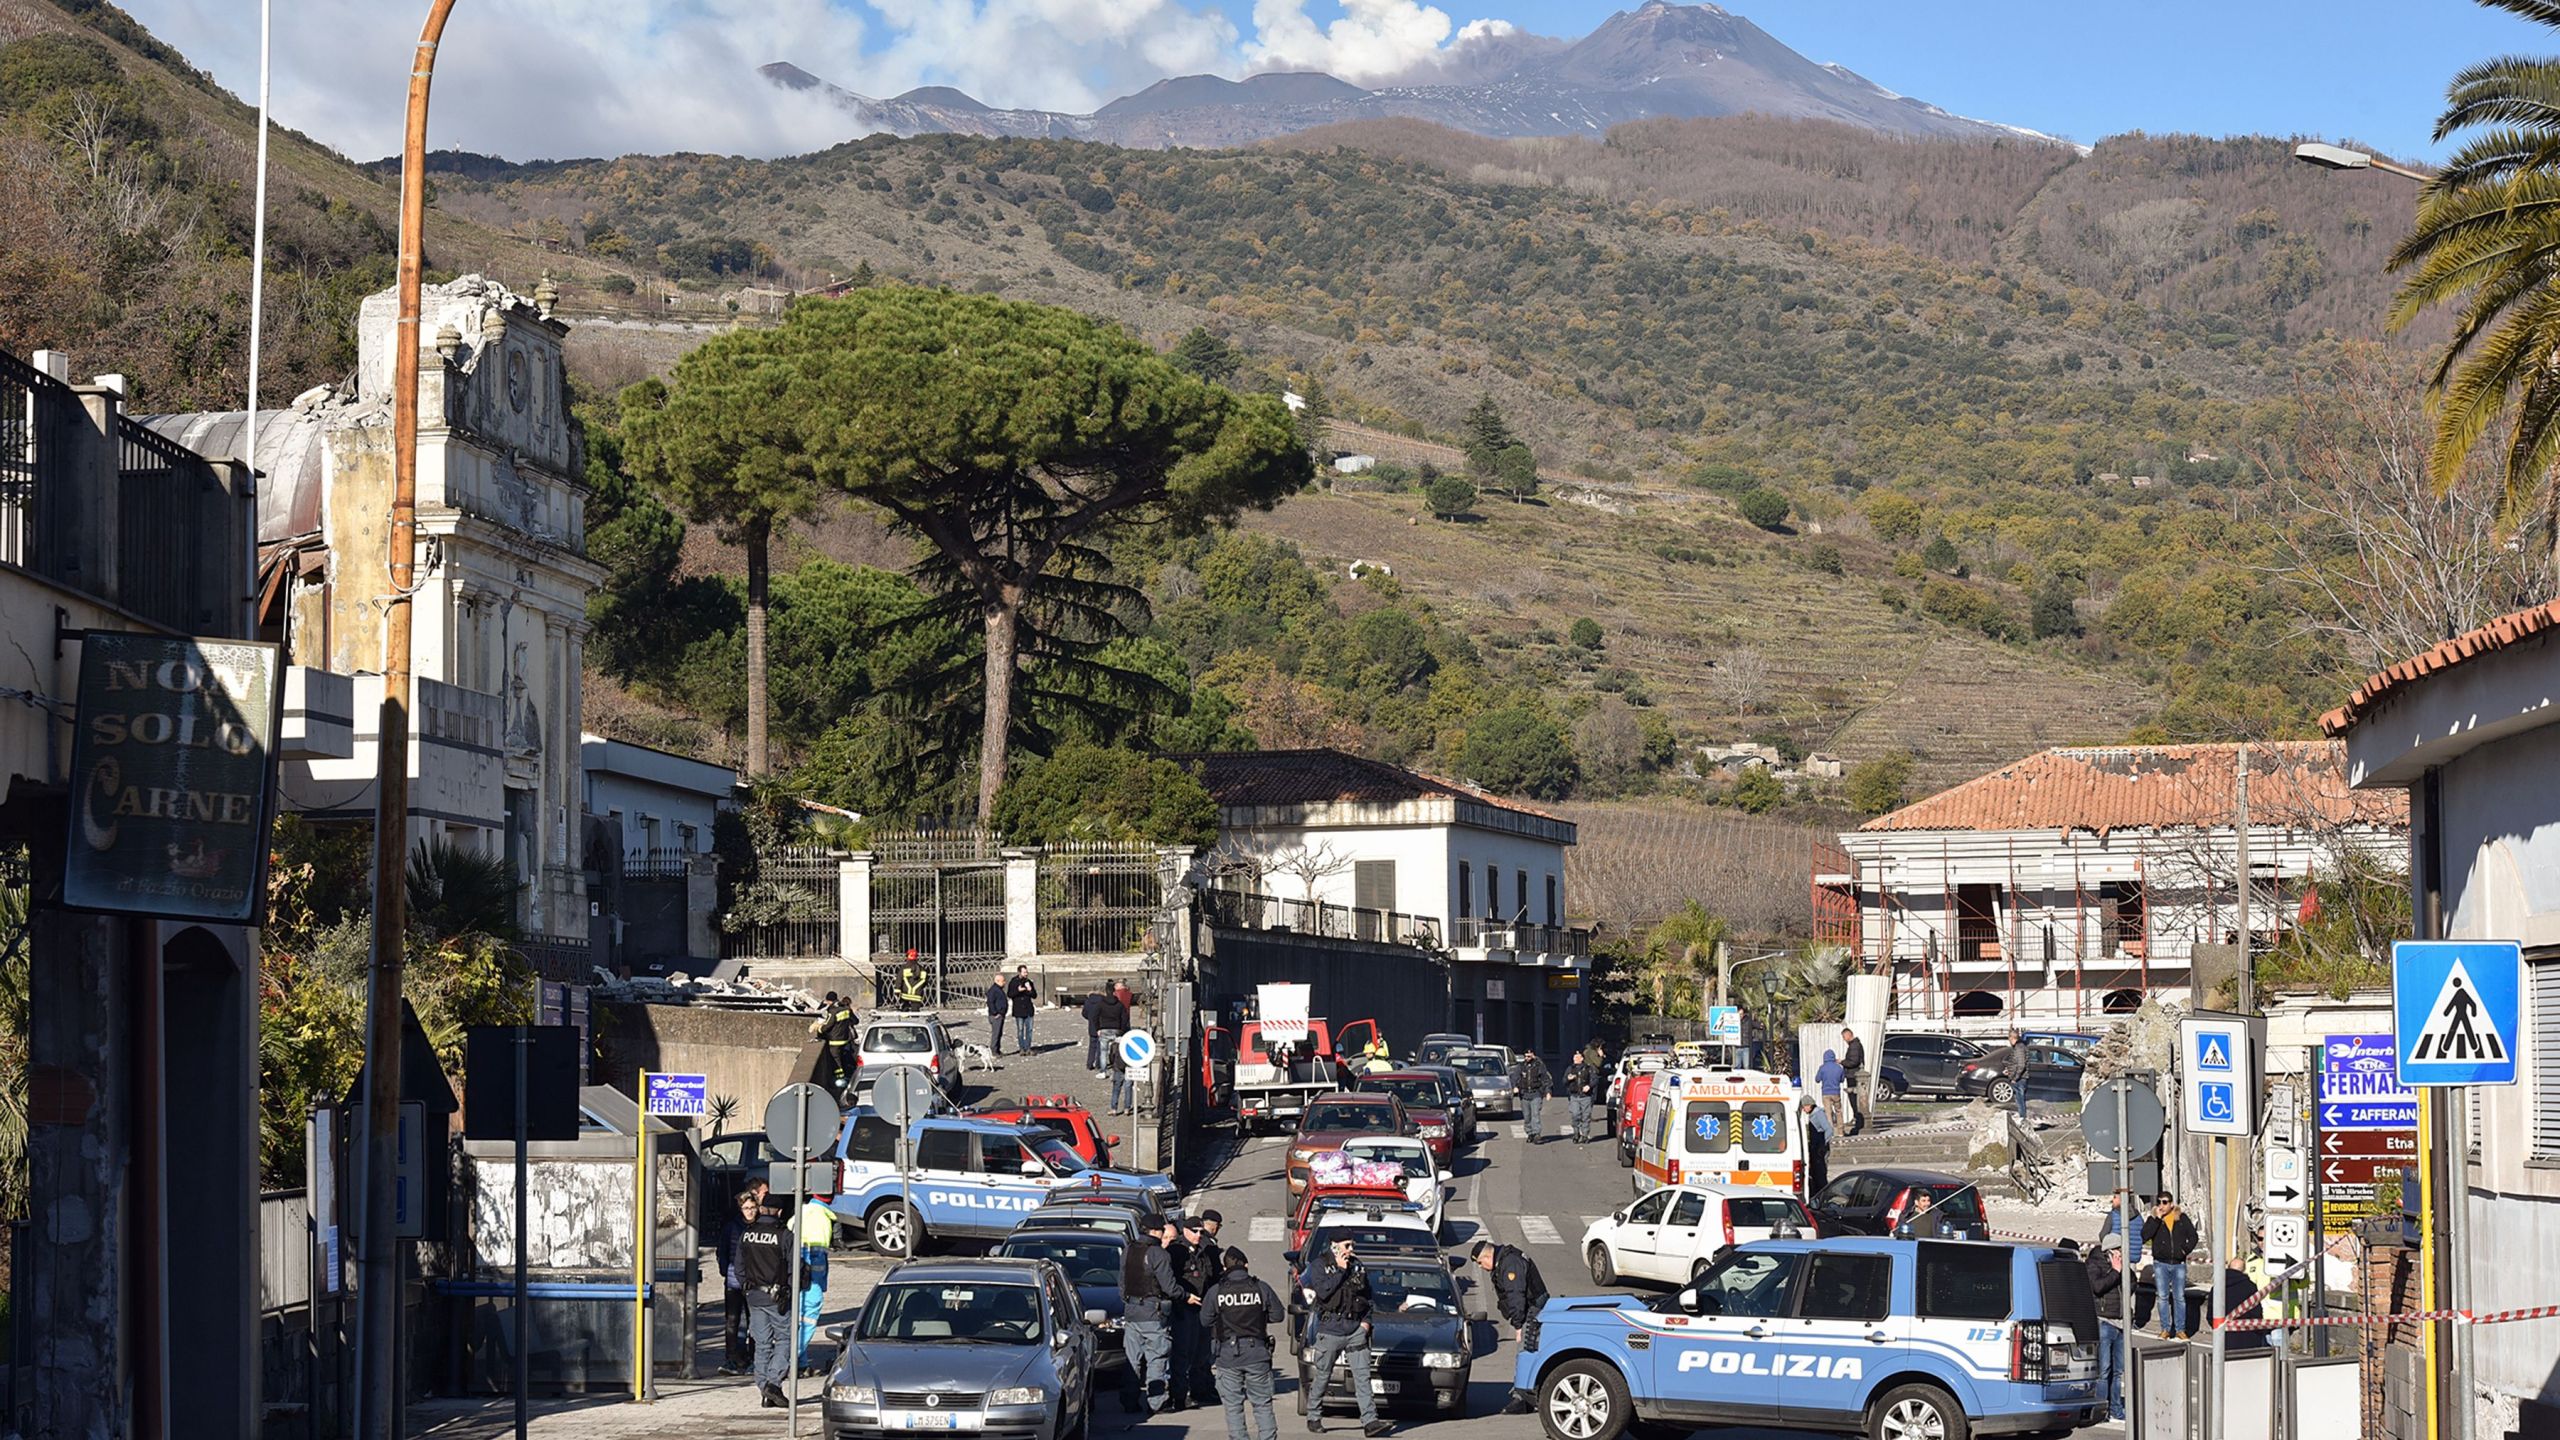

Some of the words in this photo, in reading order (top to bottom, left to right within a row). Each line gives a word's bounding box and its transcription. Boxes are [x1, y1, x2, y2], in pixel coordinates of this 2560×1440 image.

[104, 660, 258, 701] NON
[91, 711, 255, 756] SOLO
[83, 756, 252, 851] CARNE
[1688, 1085, 1781, 1096] AMBULANZA
[650, 1099, 704, 1113] FERMATA
[2350, 1108, 2417, 1121] ZAFFERAN
[2386, 1137, 2414, 1149] Etna
[850, 1165, 868, 1175] 113
[2373, 1166, 2401, 1177] Etna
[929, 1191, 1041, 1212] POLIZIA
[743, 1232, 778, 1245] POLIZIA
[1218, 1293, 1261, 1307] POLIZIA
[1967, 1328, 2003, 1342] 113
[1677, 1350, 1863, 1380] POLIZIA
